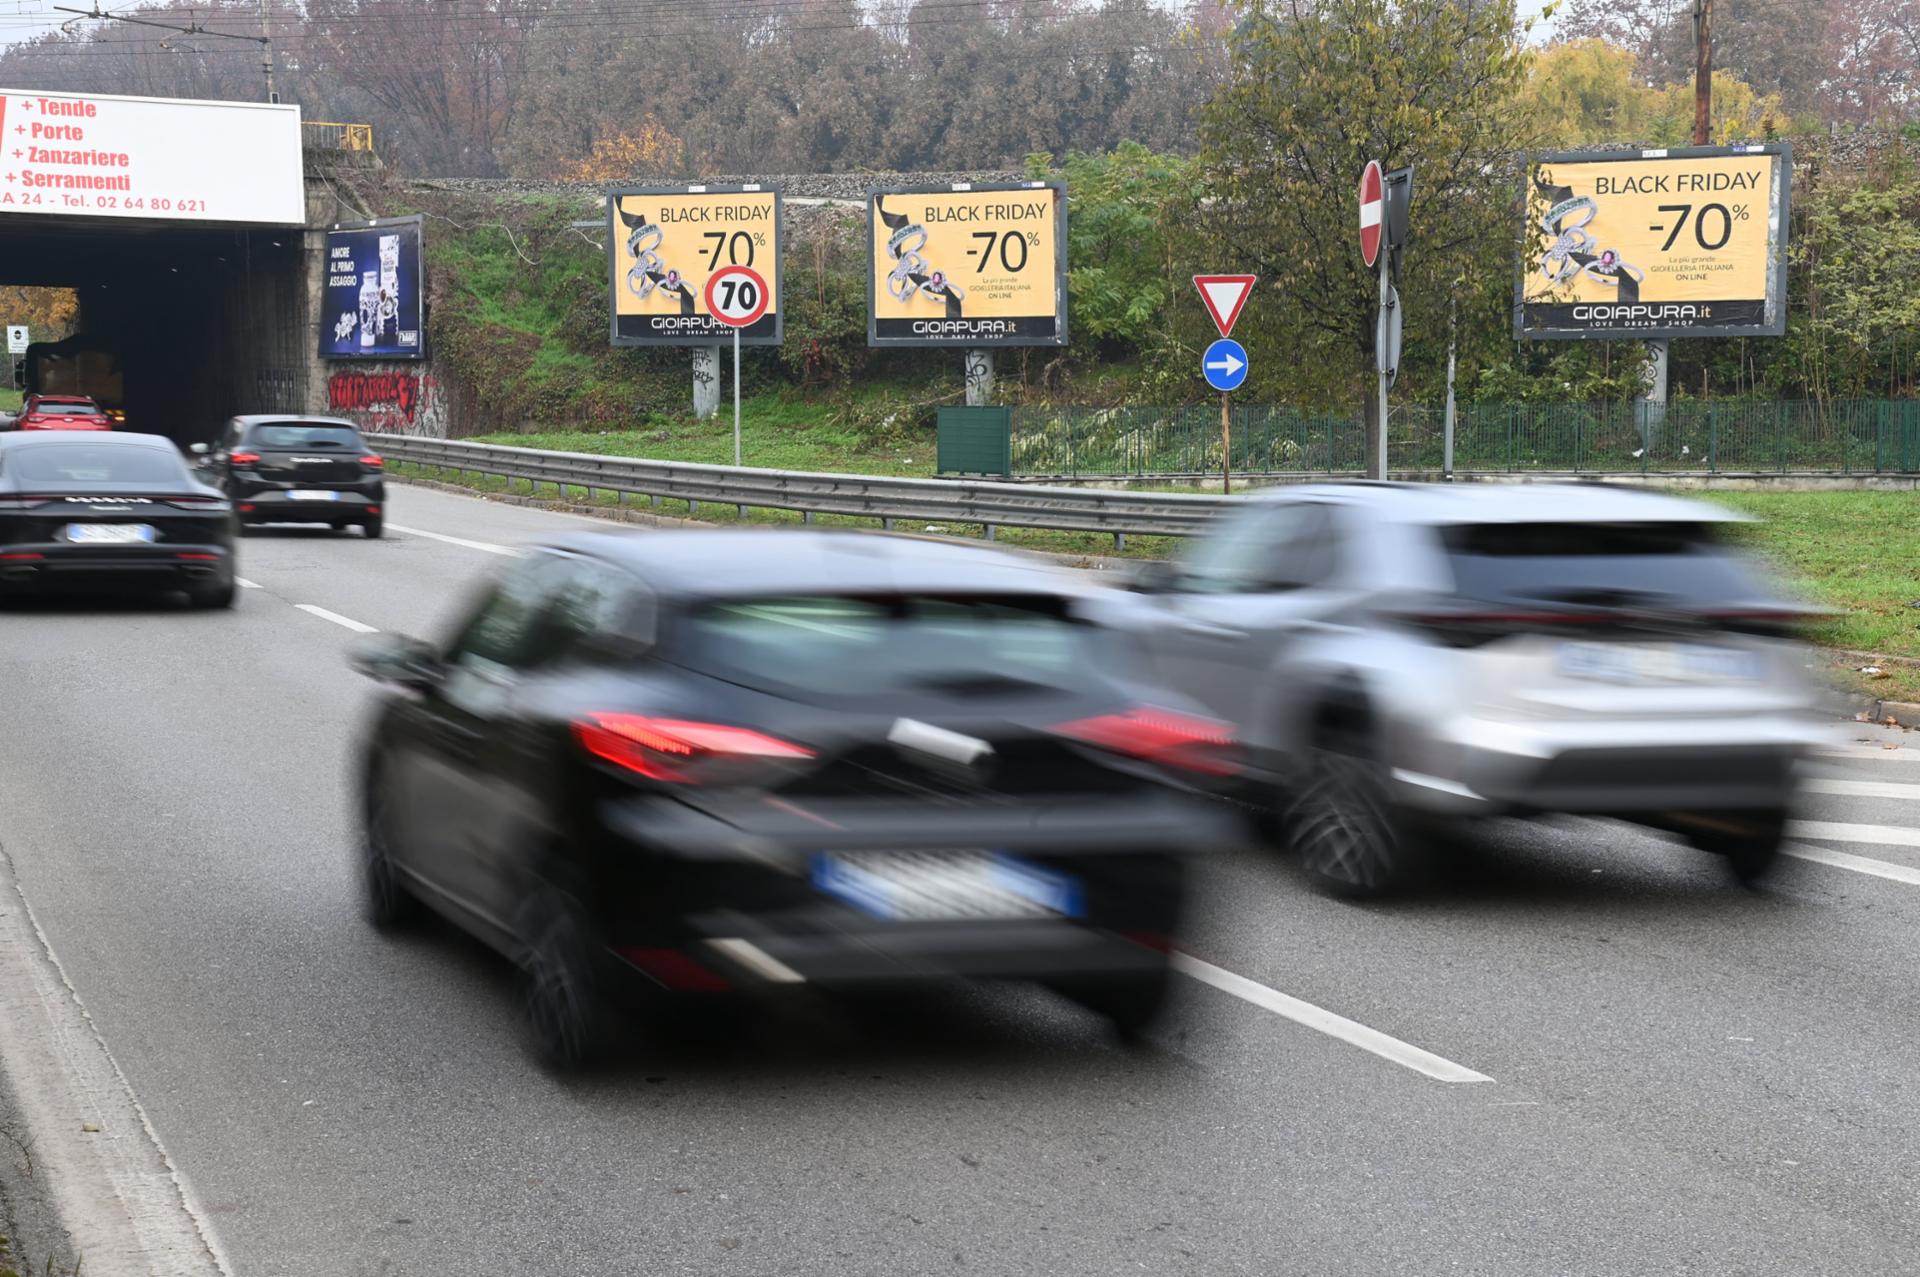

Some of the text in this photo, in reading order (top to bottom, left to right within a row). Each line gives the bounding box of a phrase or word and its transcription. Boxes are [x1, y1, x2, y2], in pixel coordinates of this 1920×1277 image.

[38, 98, 97, 118] Tende
[31, 122, 83, 141] Porte
[28, 146, 129, 167] Zanzariere
[21, 170, 131, 191] Serramenti
[1595, 171, 1761, 195] BLACK FRIDAY
[21, 192, 42, 205] 24
[62, 194, 91, 207] Tel.
[97, 196, 117, 209] 02
[124, 197, 144, 209] 64
[151, 199, 171, 210] 80
[177, 199, 206, 212] 621
[661, 205, 772, 223] BLACK FRIDAY
[925, 203, 1047, 223] BLACK FRIDAY
[1650, 203, 1749, 251] -70%
[332, 248, 350, 258] AMORE
[699, 231, 766, 272] -70%
[967, 231, 1040, 273] -70%
[1691, 256, 1716, 264] grande
[330, 262, 354, 272] AL PRIMO
[1651, 265, 1696, 273] GIOIELLERIA
[330, 276, 357, 287] ASSAGGIO
[1690, 273, 1707, 281] LINE
[721, 281, 757, 310] 70
[1573, 305, 1712, 320] GIOIAPURA.it
[912, 320, 1016, 333] GIOIAPURA.it
